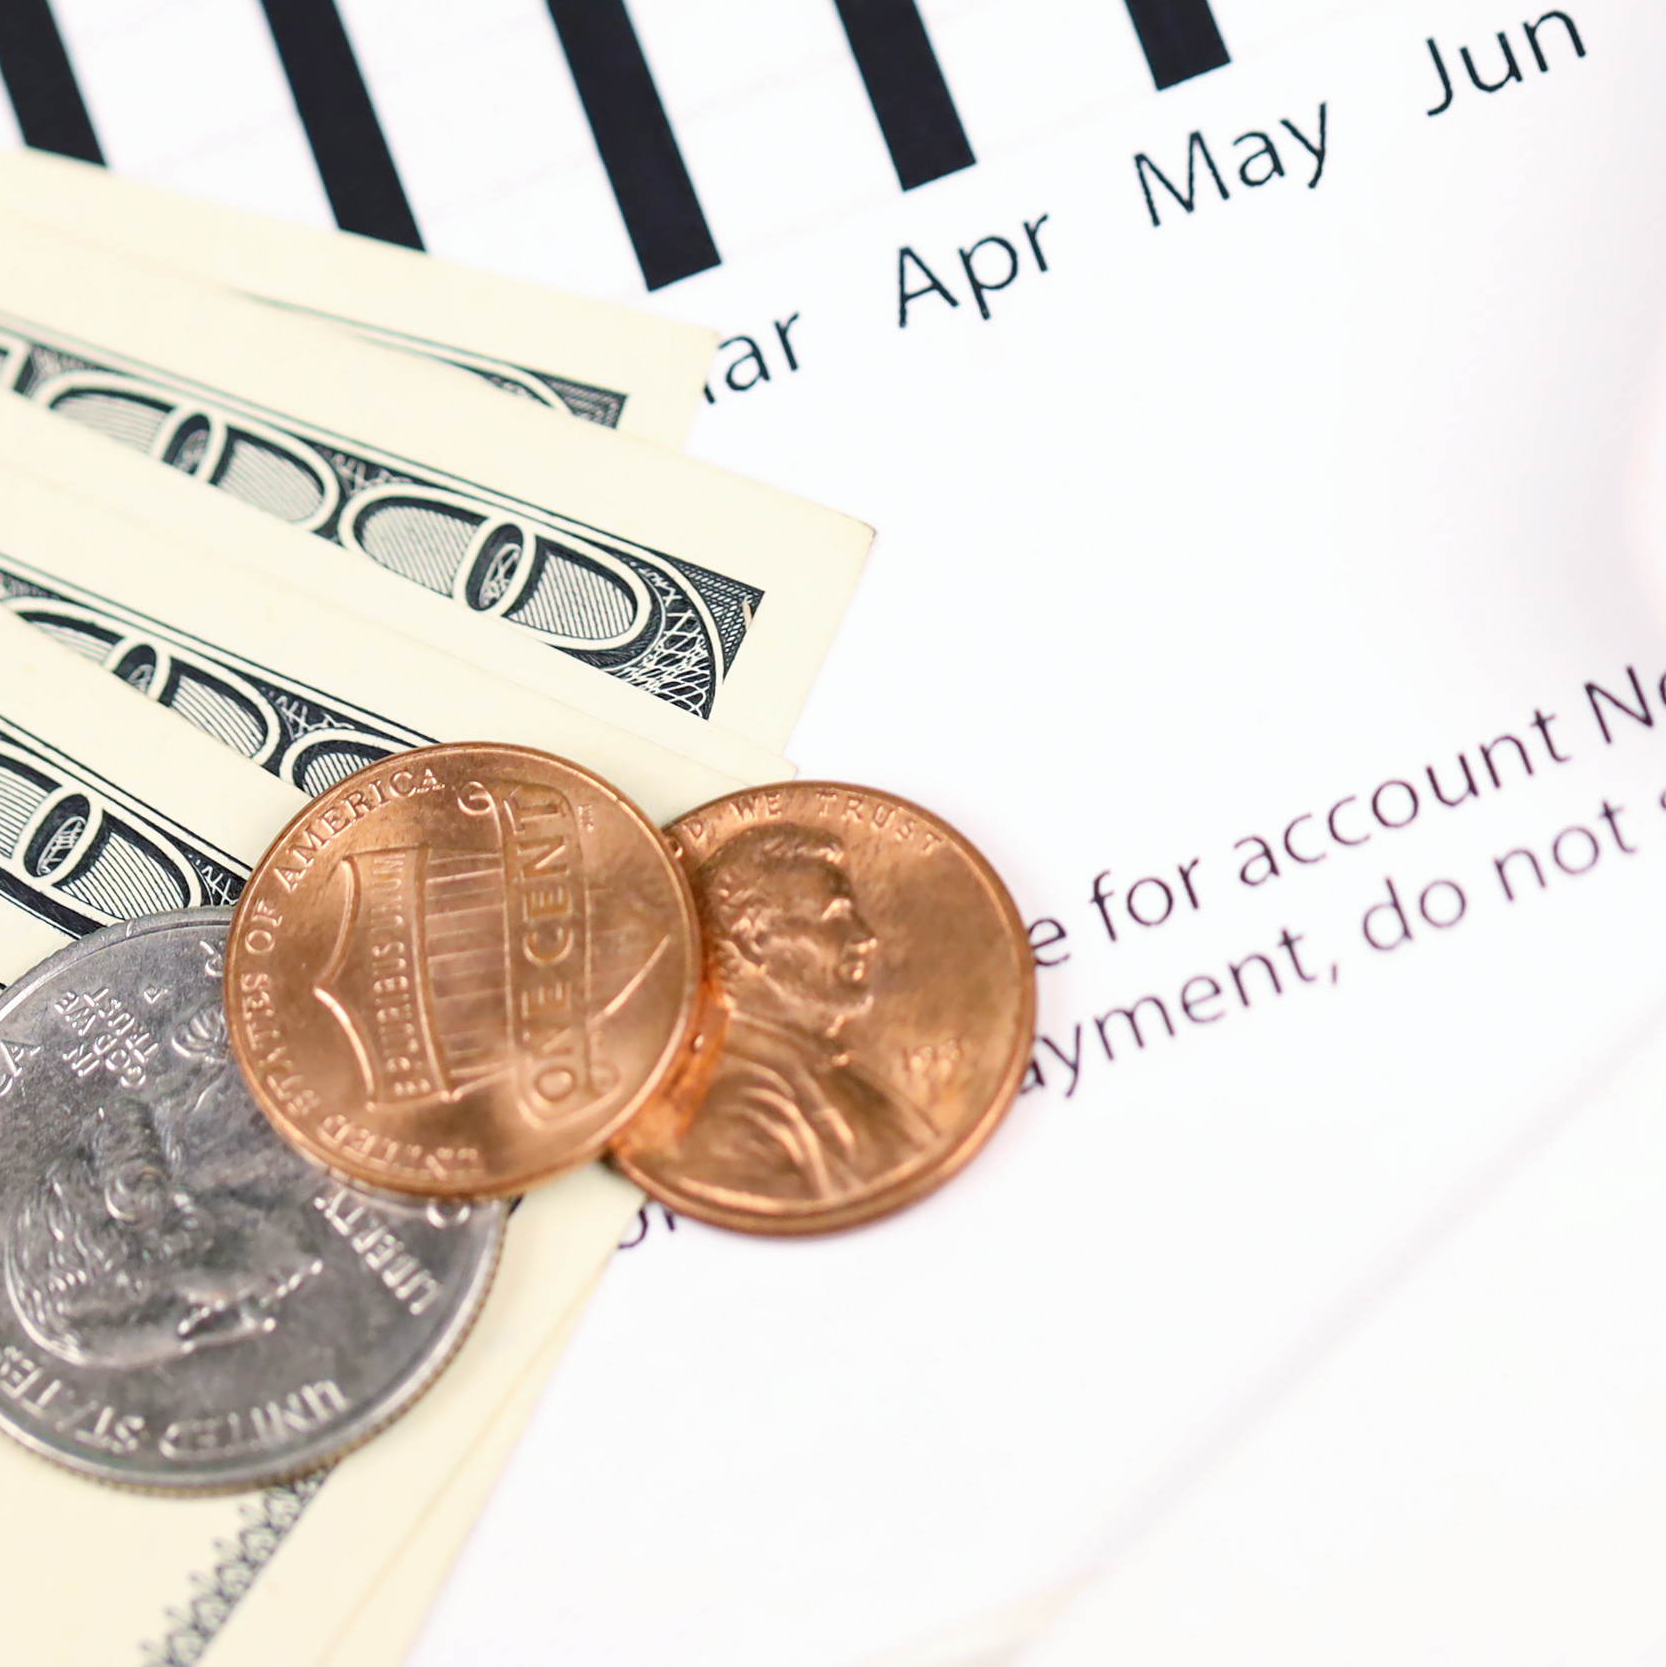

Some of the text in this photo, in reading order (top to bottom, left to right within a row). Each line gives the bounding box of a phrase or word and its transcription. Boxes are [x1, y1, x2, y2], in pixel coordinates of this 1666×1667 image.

[896, 214, 1051, 322] Apr
[1134, 102, 1328, 227] May
[1426, 8, 1587, 118] Jun
[243, 898, 283, 958] OF
[272, 767, 447, 894] AMERICA
[733, 788, 945, 860] WE TRUST
[1089, 866, 1200, 943] for
[1233, 707, 1573, 888] account
[1362, 876, 1468, 952] do
[1493, 798, 1637, 904] not
[516, 794, 579, 1106] ONE CENT
[156, 1378, 353, 1461] UNITED
